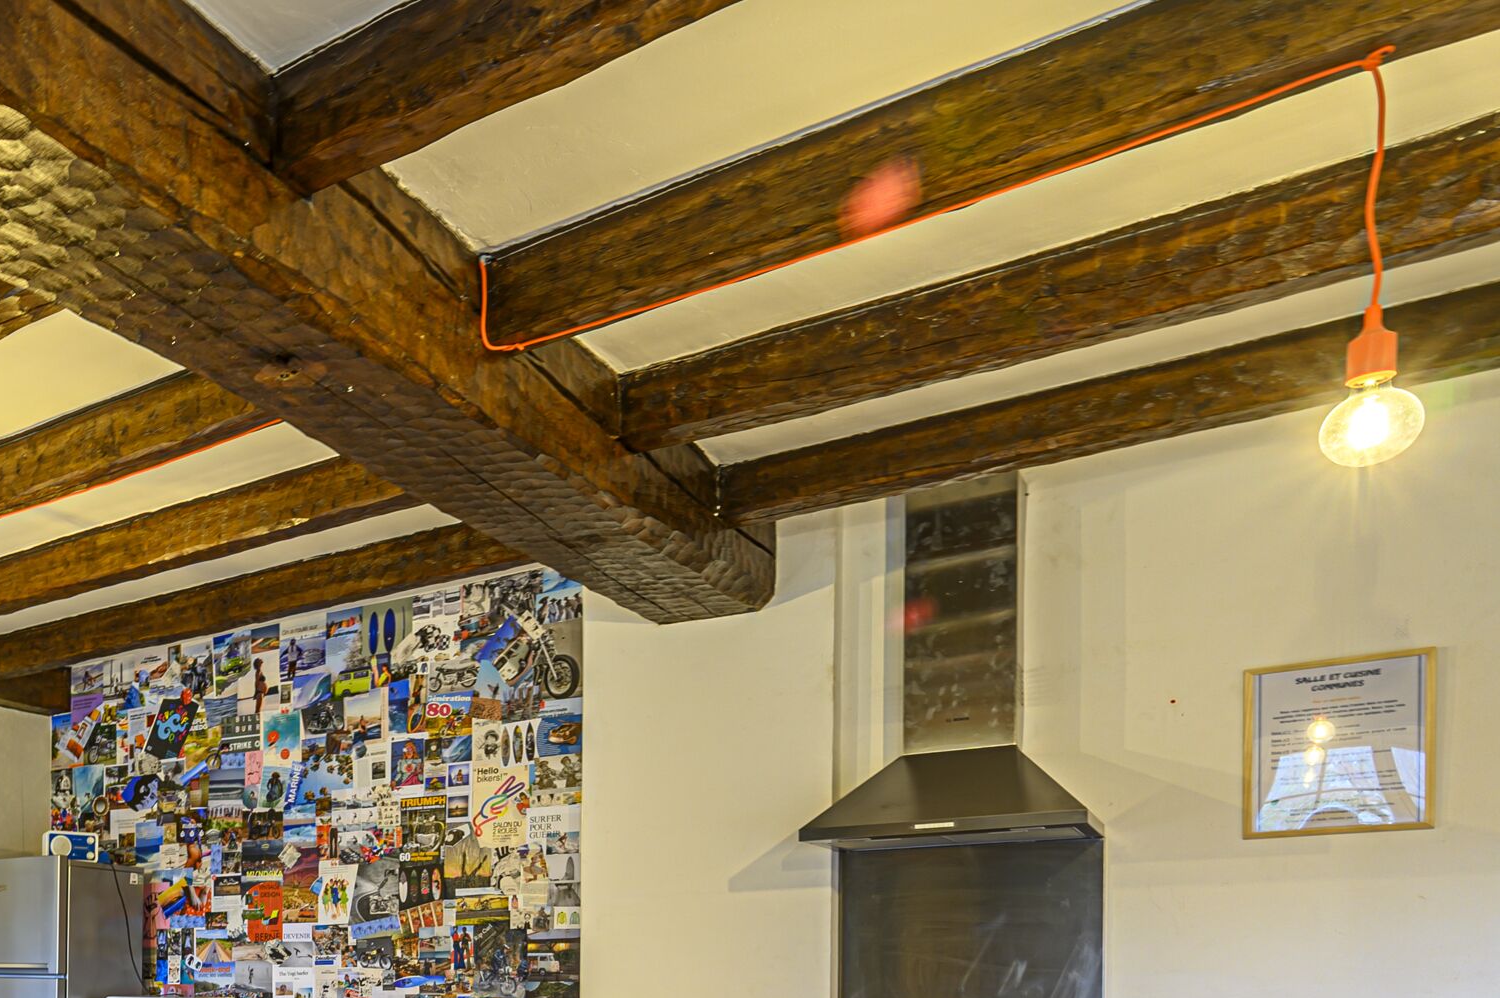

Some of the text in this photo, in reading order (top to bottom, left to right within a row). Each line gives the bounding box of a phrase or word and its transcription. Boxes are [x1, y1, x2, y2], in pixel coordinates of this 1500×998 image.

[1295, 668, 1382, 685] SALLE ET CUISINE
[426, 701, 452, 718] 80
[229, 740, 252, 751] STRIKE
[288, 764, 304, 803] MARINE
[401, 795, 446, 807] TRIUMPH
[529, 814, 562, 823] SURFER
[529, 823, 552, 831] POUR
[399, 852, 411, 862] 60
[283, 932, 311, 940] DEVENIR
